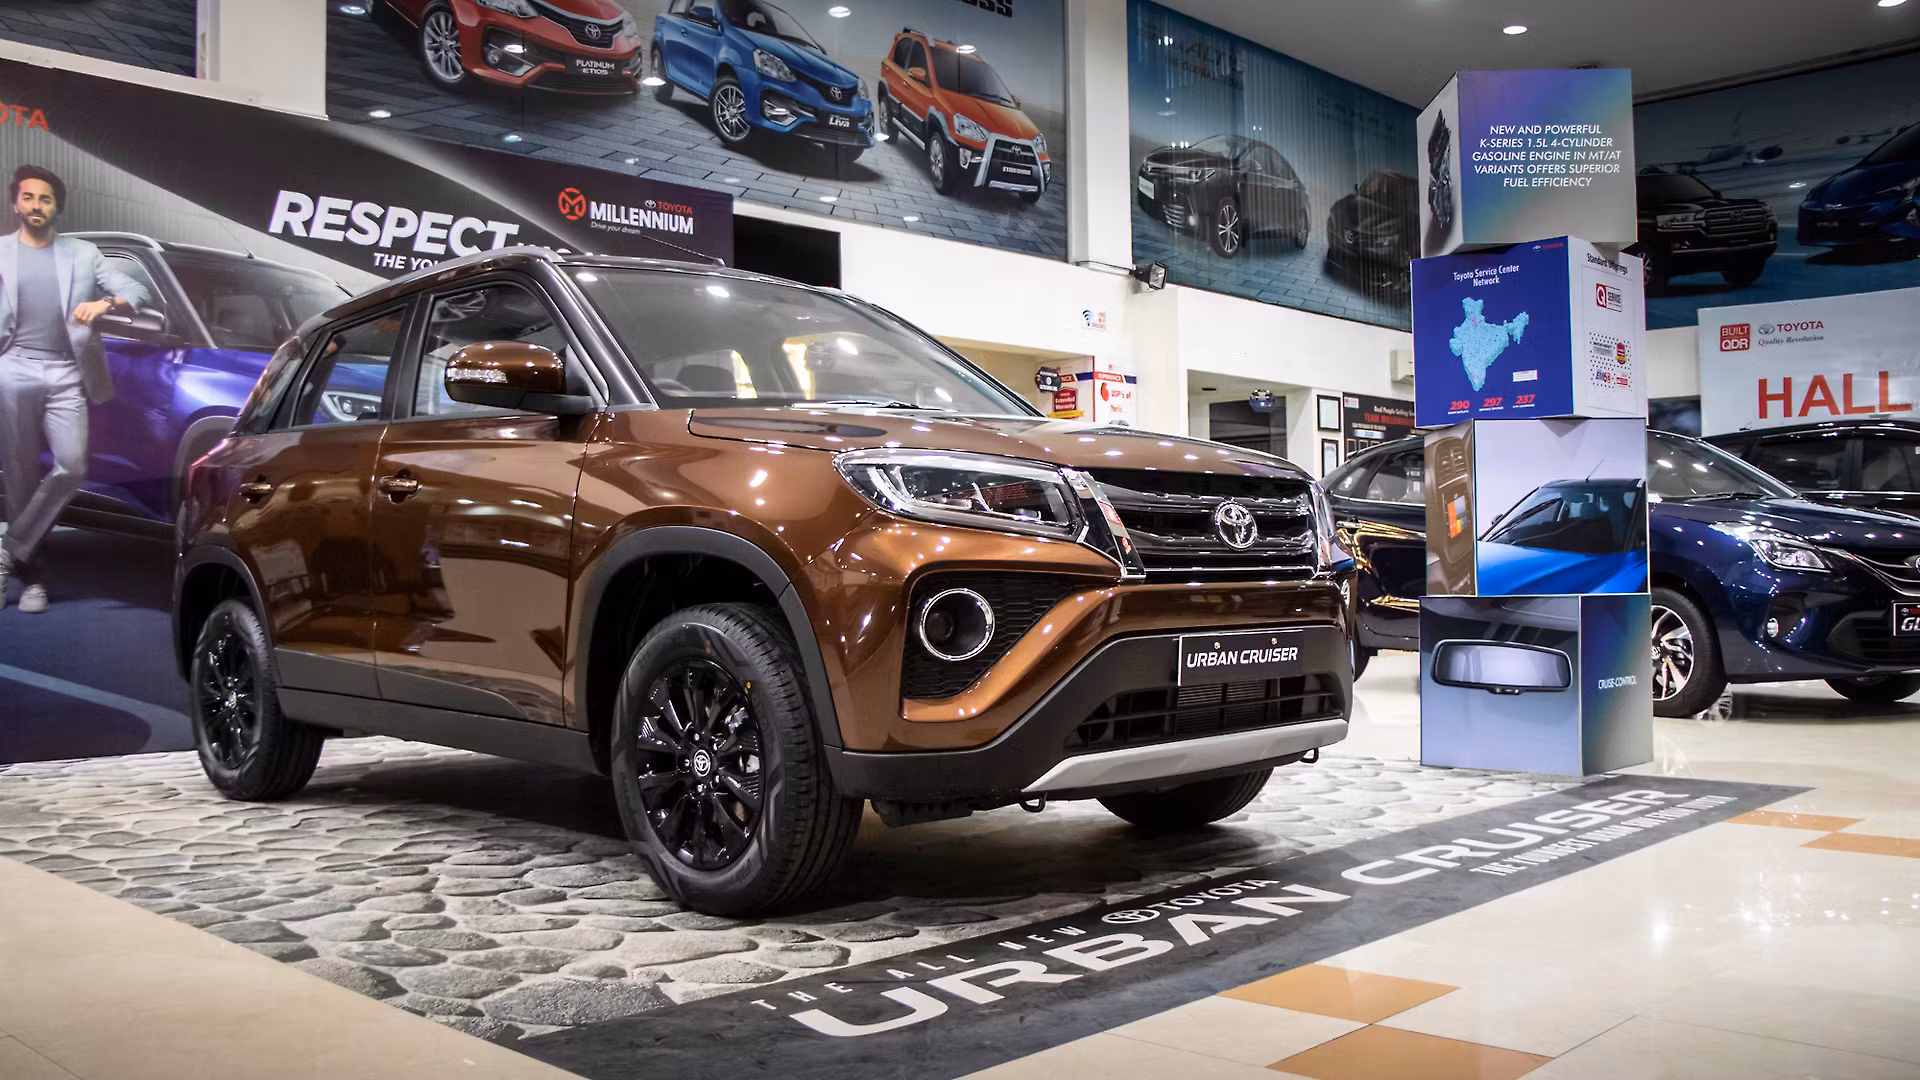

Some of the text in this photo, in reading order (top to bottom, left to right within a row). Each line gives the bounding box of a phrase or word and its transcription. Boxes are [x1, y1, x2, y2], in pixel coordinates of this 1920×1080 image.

[576, 59, 615, 70] PLATINUM
[829, 117, 850, 128] Liva
[1490, 124, 1602, 135] NEW AND POWERFUL
[1479, 137, 1613, 148] K-SERIES 1.5L 4-CYLINDER
[1472, 150, 1622, 161] GASOLINE ENGINE IN MT/AT
[1474, 163, 1620, 174] VARIANTS OFFERS SUPERIOR
[1503, 177, 1592, 187] FUEL EFFICIENCY
[657, 201, 693, 214] TOYOTA
[268, 189, 519, 257] RESPECT
[590, 201, 694, 235] MILLENNIUM
[591, 221, 641, 235] Drive your dream
[373, 252, 439, 271] THE YO
[1453, 264, 1520, 282] Toyota Service Center
[1472, 275, 1500, 287] Network
[1721, 326, 1749, 337] BUILT
[1776, 321, 1824, 333] TOYOTA
[1721, 338, 1749, 350] QDR
[1758, 335, 1824, 346] Quality Revolution
[1758, 370, 1913, 419] HALL
[1186, 647, 1299, 668] URBAN CRUISER
[788, 789, 1690, 1037] URBAN CRUISER
[751, 879, 1280, 1010] THE ALL NEW TOYOTA
